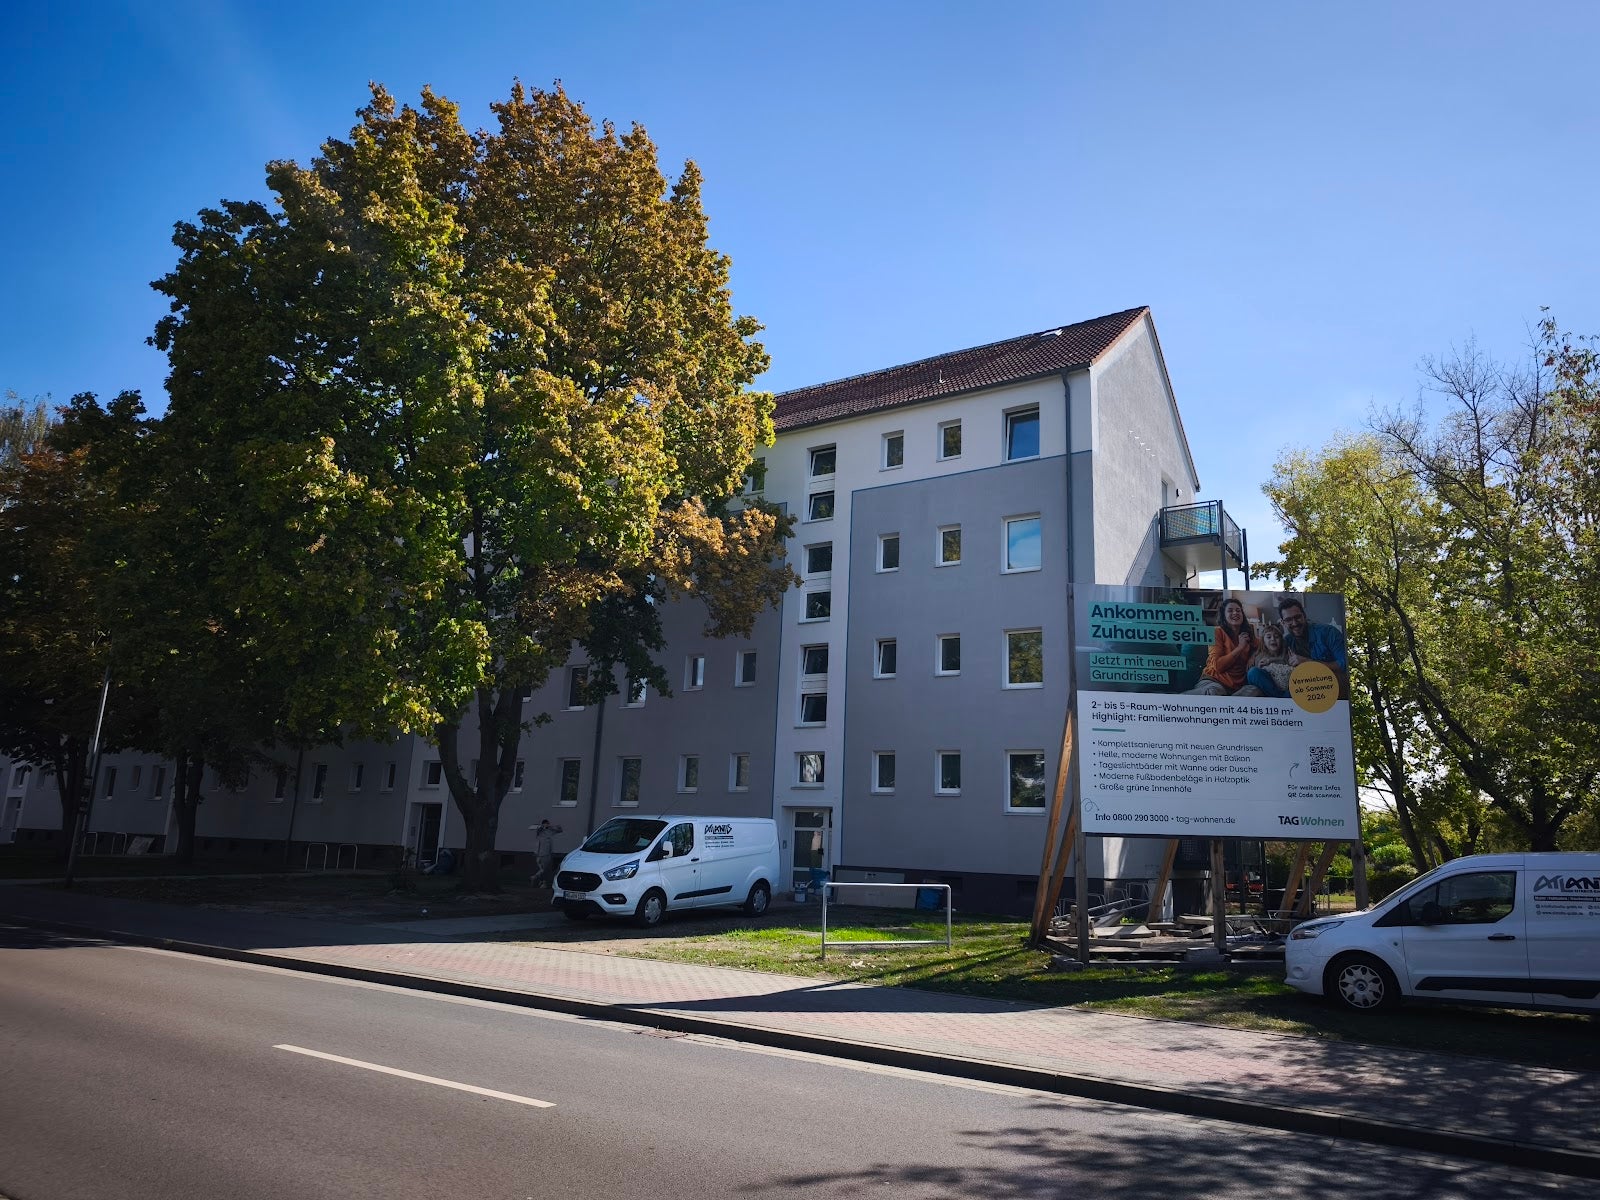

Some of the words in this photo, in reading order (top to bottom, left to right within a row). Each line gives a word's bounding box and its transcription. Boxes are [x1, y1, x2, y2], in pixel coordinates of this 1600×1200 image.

[1092, 604, 1200, 621] Ankommen.
[1092, 624, 1167, 640] Zuhause
[1172, 627, 1212, 642] sein.
[1092, 656, 1120, 666] Jetzt
[1124, 656, 1144, 666] mit
[1148, 659, 1184, 668] neuen
[1092, 670, 1166, 682] Grundrissen.
[1292, 675, 1332, 684] Vermietung
[1306, 684, 1333, 692] Sommer
[1092, 701, 1101, 709] 2-
[1120, 702, 1216, 714] 5-Raum-Wohnungen
[1220, 706, 1234, 714] mit
[1250, 707, 1263, 715] bis
[1092, 712, 1136, 723] Highlight:
[1139, 714, 1229, 726] Familienwohnungen
[1232, 716, 1247, 725] mit
[1250, 718, 1269, 726] zwei
[1271, 718, 1303, 727] Bädern
[1098, 740, 1173, 751] Komplettsanierung
[1160, 753, 1207, 762] Wohnungen
[1099, 762, 1162, 770] Tageslichtbäder
[1136, 774, 1203, 784] Fußbodenbeläge
[1215, 776, 1250, 784] Holzoptik
[1126, 785, 1149, 793] grüne
[1176, 816, 1236, 824] tag-wohnen.de
